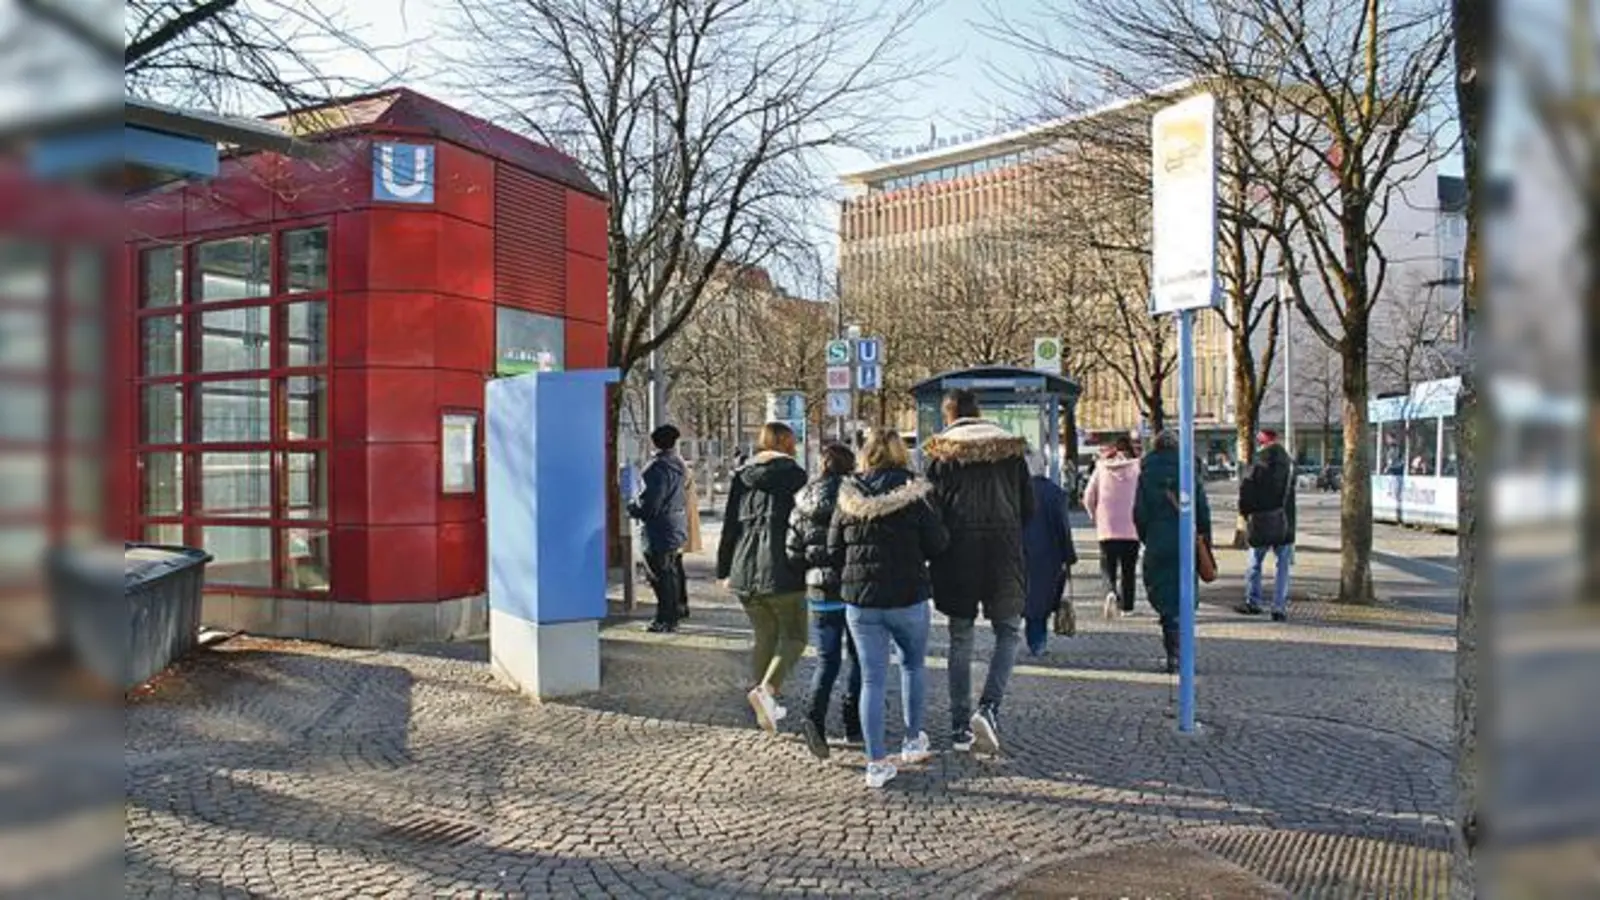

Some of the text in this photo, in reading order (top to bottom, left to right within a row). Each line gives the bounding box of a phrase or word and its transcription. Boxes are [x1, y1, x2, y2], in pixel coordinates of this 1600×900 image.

[382, 146, 426, 197] U
[830, 343, 846, 360] S
[860, 342, 877, 361] U
